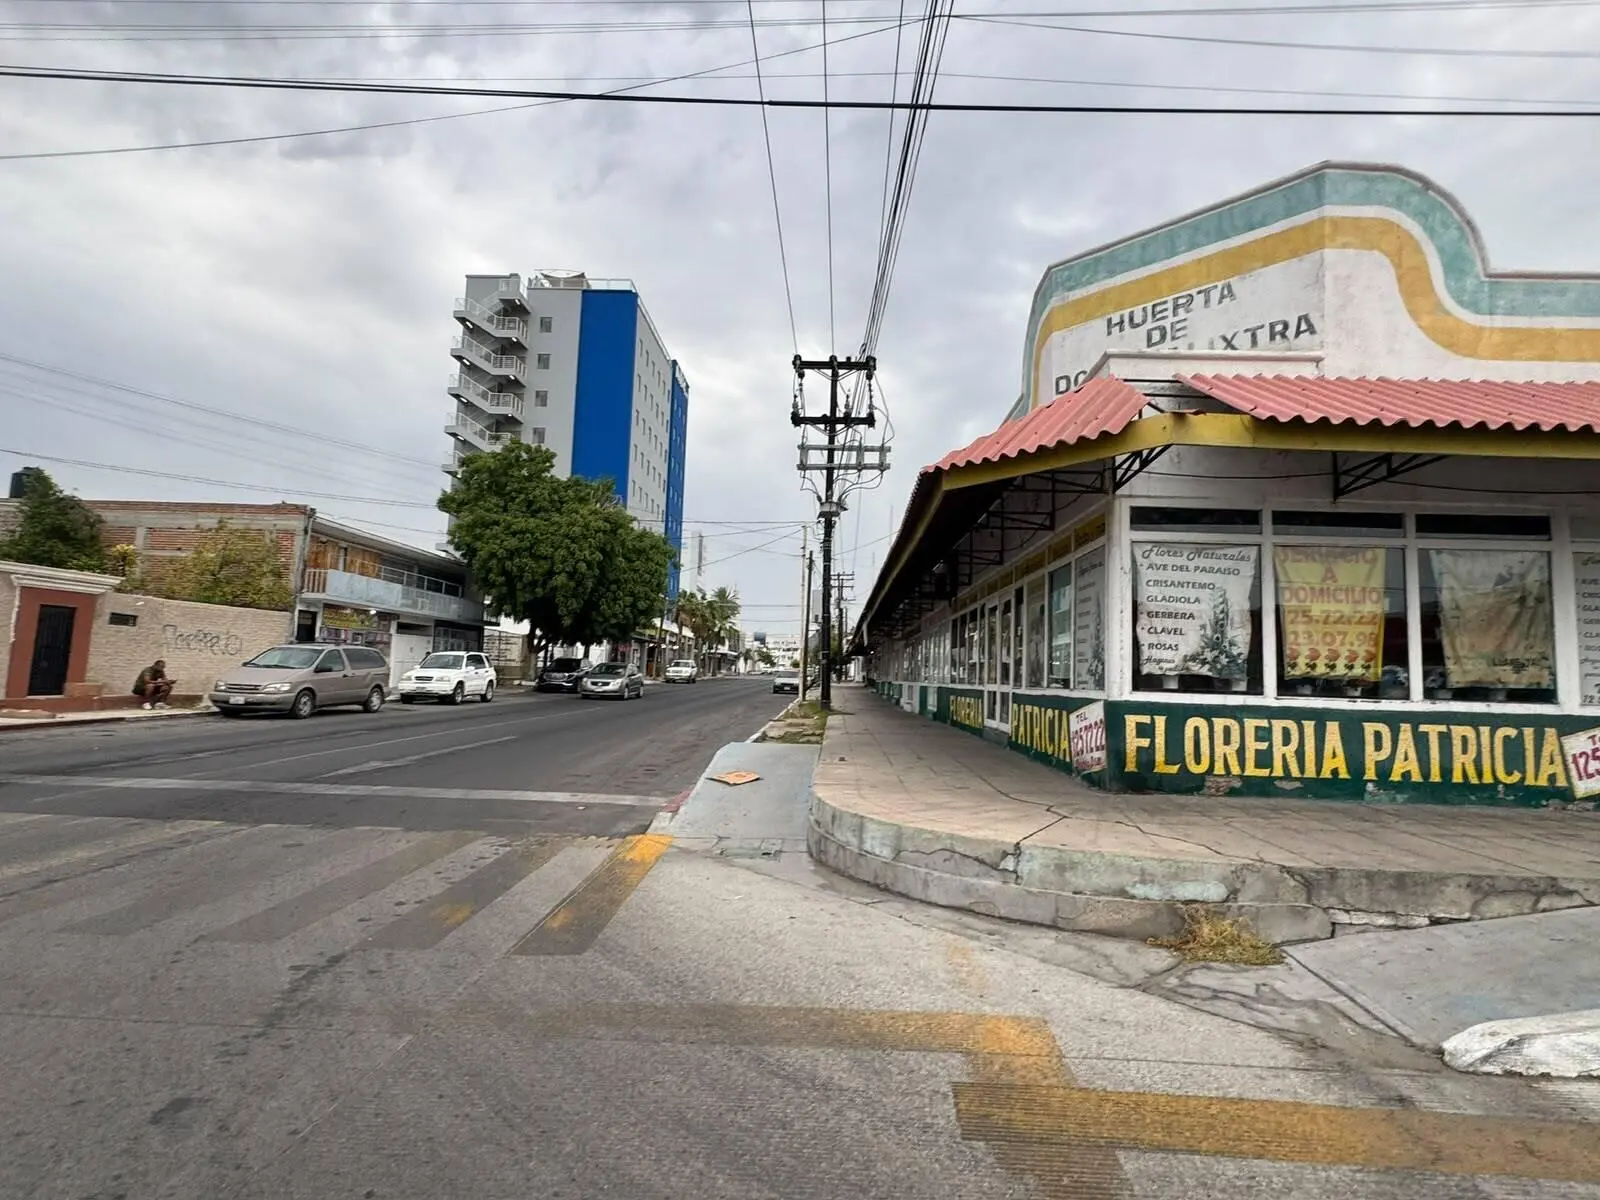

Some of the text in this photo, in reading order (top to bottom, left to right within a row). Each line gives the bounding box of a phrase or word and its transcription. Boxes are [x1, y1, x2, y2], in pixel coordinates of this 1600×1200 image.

[1106, 280, 1236, 337] HUERTA
[1146, 318, 1188, 348] DE
[1142, 545, 1251, 562] Flores Naturales
[1146, 563, 1240, 576] AVE DEL PARAISO
[1322, 563, 1338, 583] A
[1145, 579, 1216, 590] CRISANTEMO
[1146, 595, 1201, 605] GLADIOLA
[1146, 610, 1196, 620] GERBERA
[1147, 626, 1185, 636] CLAVEL
[1147, 642, 1179, 651] ROSAS
[950, 696, 983, 728] FLORERIA
[1010, 703, 1072, 763] PATRICIA
[1123, 714, 1568, 787] FLORERIA PATRICIA
